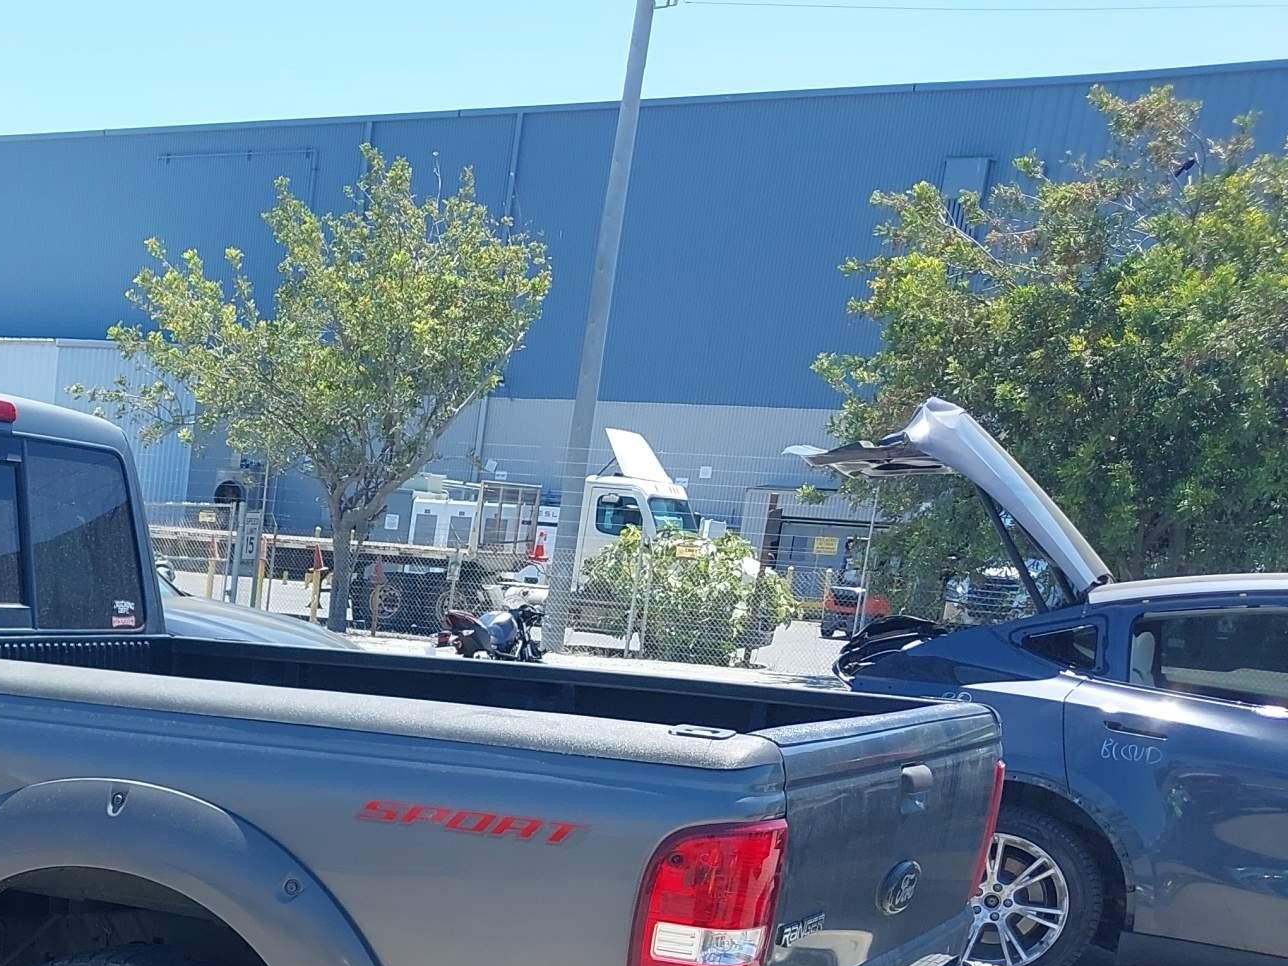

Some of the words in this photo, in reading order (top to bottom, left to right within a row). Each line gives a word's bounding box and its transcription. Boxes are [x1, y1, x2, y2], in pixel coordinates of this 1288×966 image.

[245, 535, 255, 554] 15
[360, 800, 591, 844] SPORT
[782, 913, 825, 947] RANGER
